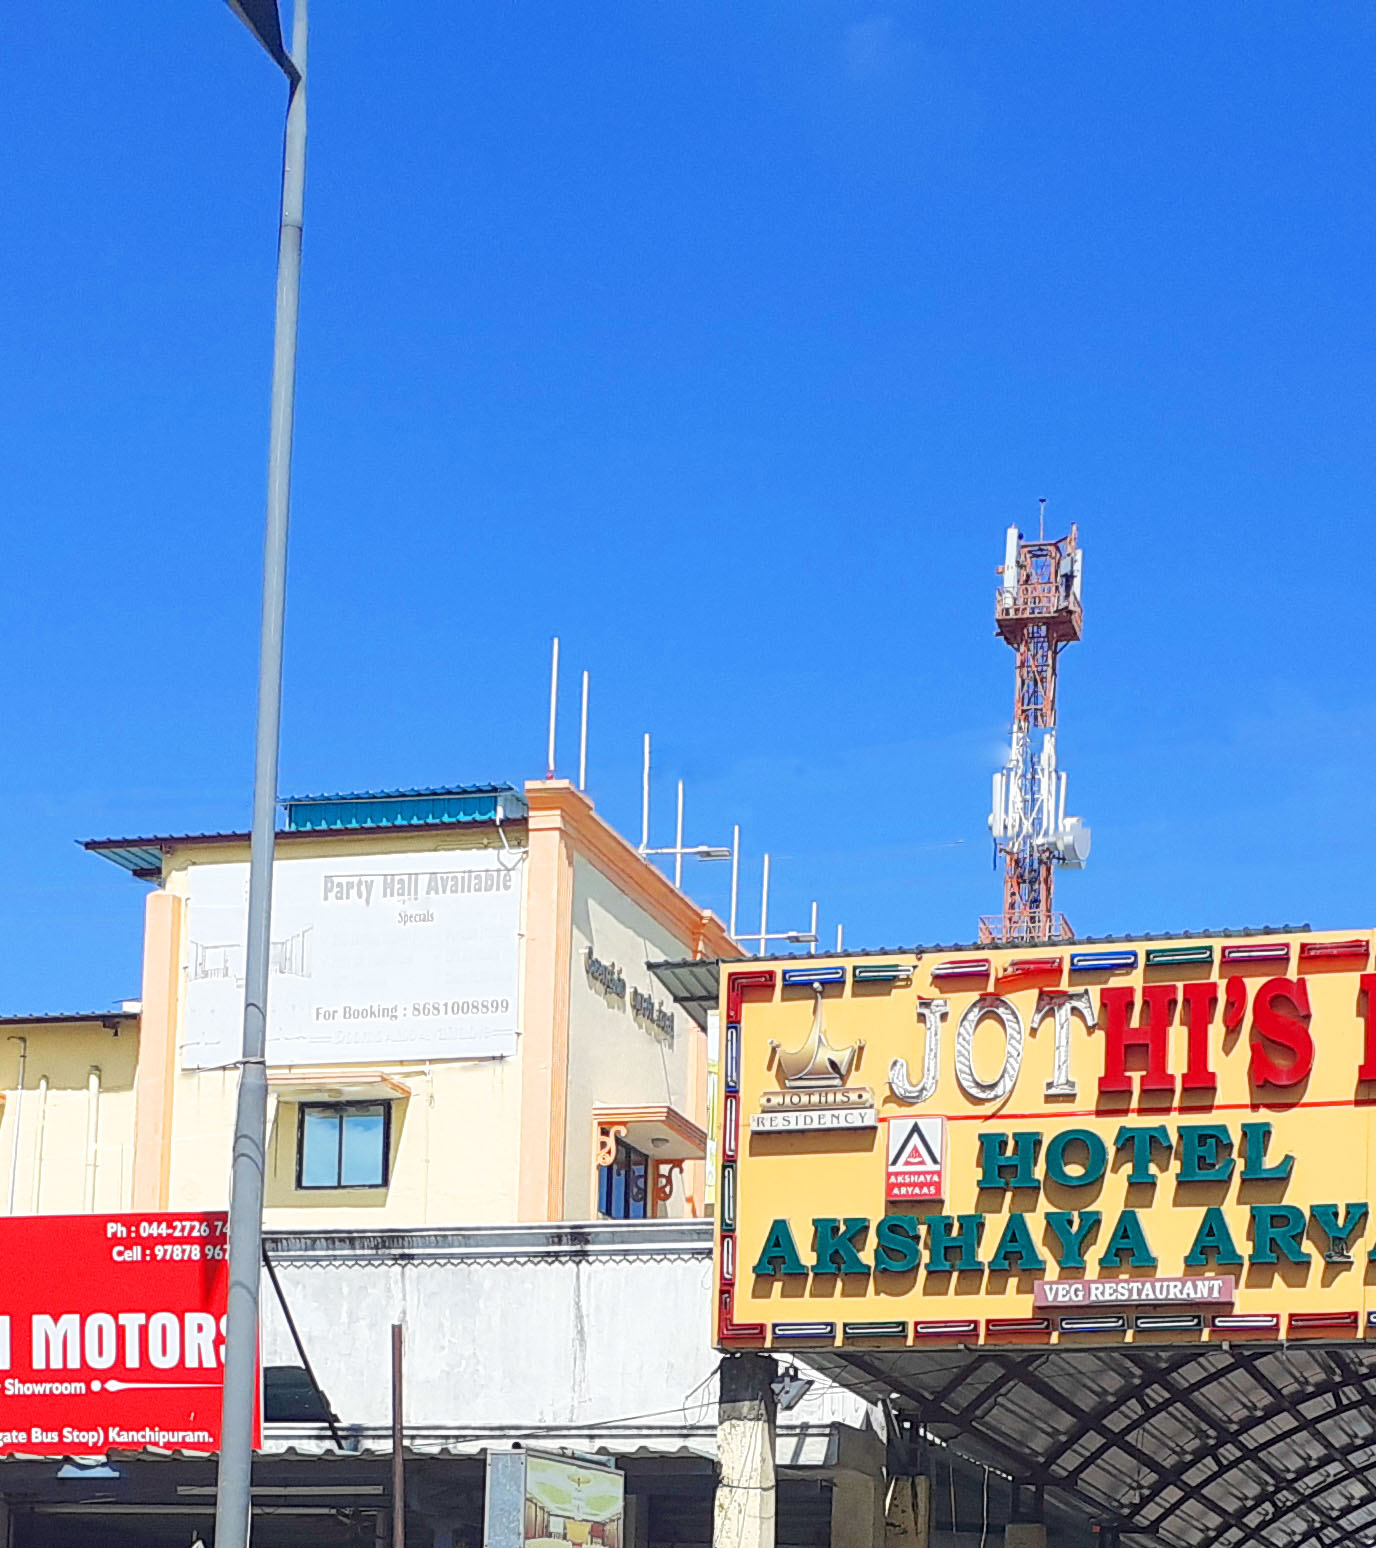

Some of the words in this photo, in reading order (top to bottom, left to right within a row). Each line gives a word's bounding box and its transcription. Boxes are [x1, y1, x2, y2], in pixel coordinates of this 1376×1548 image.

[323, 876, 374, 906] Party
[382, 873, 420, 899] Hall
[425, 868, 513, 895] Available
[397, 909, 435, 926] Specials
[315, 1007, 338, 1021] For
[342, 1004, 399, 1020] Booking
[411, 998, 510, 1018] 8681008899
[888, 974, 1316, 1104] JOTHI'S
[776, 1091, 852, 1107] JOTHIS
[755, 1112, 869, 1128] RESIDENCY
[976, 1122, 1296, 1191] HOTEL
[888, 1173, 940, 1184] AKSHAYA
[891, 1185, 936, 1196] ARYAAS
[106, 1222, 127, 1238] Ph
[139, 1221, 210, 1238] 044-2726
[751, 1207, 1160, 1277] AKSHAYA
[112, 1245, 142, 1262] Cell
[154, 1244, 201, 1261] 97878
[1043, 1283, 1085, 1304] VEG
[1089, 1279, 1223, 1301] RESTAURANT
[31, 1312, 227, 1370] MOTOR
[4, 1378, 86, 1396] Showroom
[31, 1427, 59, 1444] Bus
[62, 1427, 104, 1446] Stop)
[108, 1427, 214, 1446] Kanchipuram.
